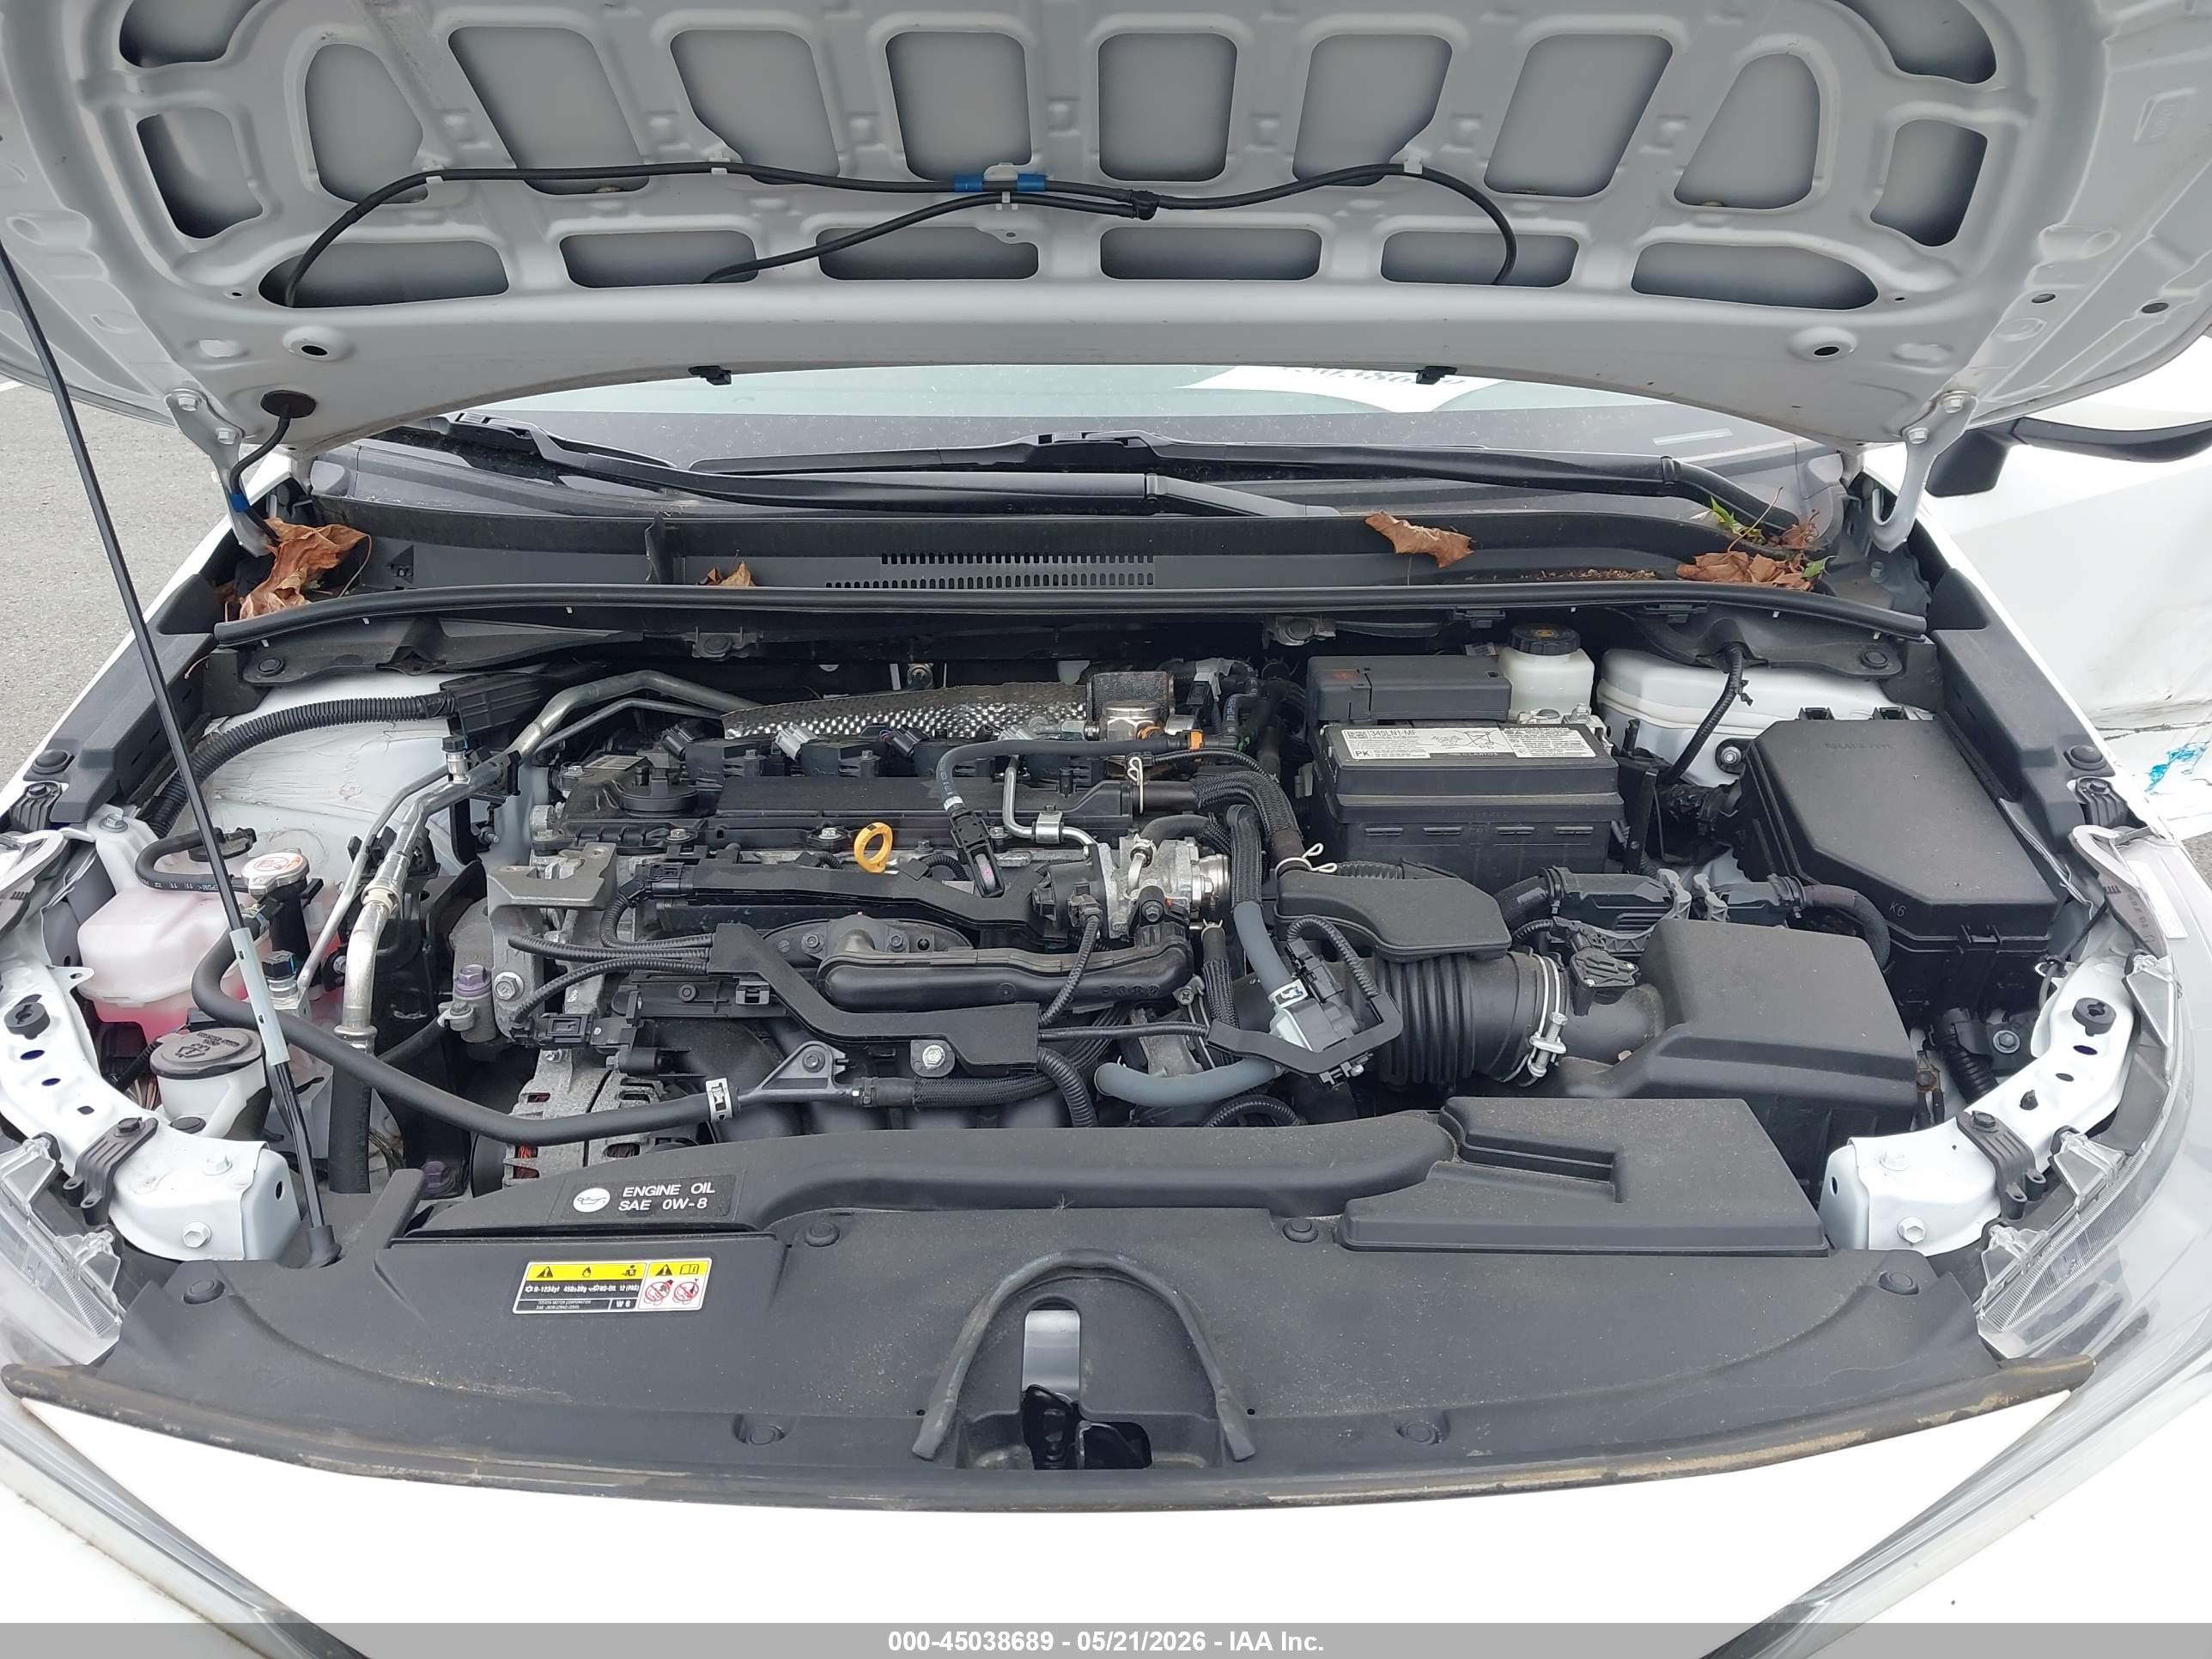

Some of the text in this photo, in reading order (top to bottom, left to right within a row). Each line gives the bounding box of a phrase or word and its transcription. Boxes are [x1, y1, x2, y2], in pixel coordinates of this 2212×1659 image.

[1889, 901, 1906, 917] K6
[623, 1182, 715, 1198] ENGINE OIL
[617, 1197, 708, 1212] SAE 0W-8
